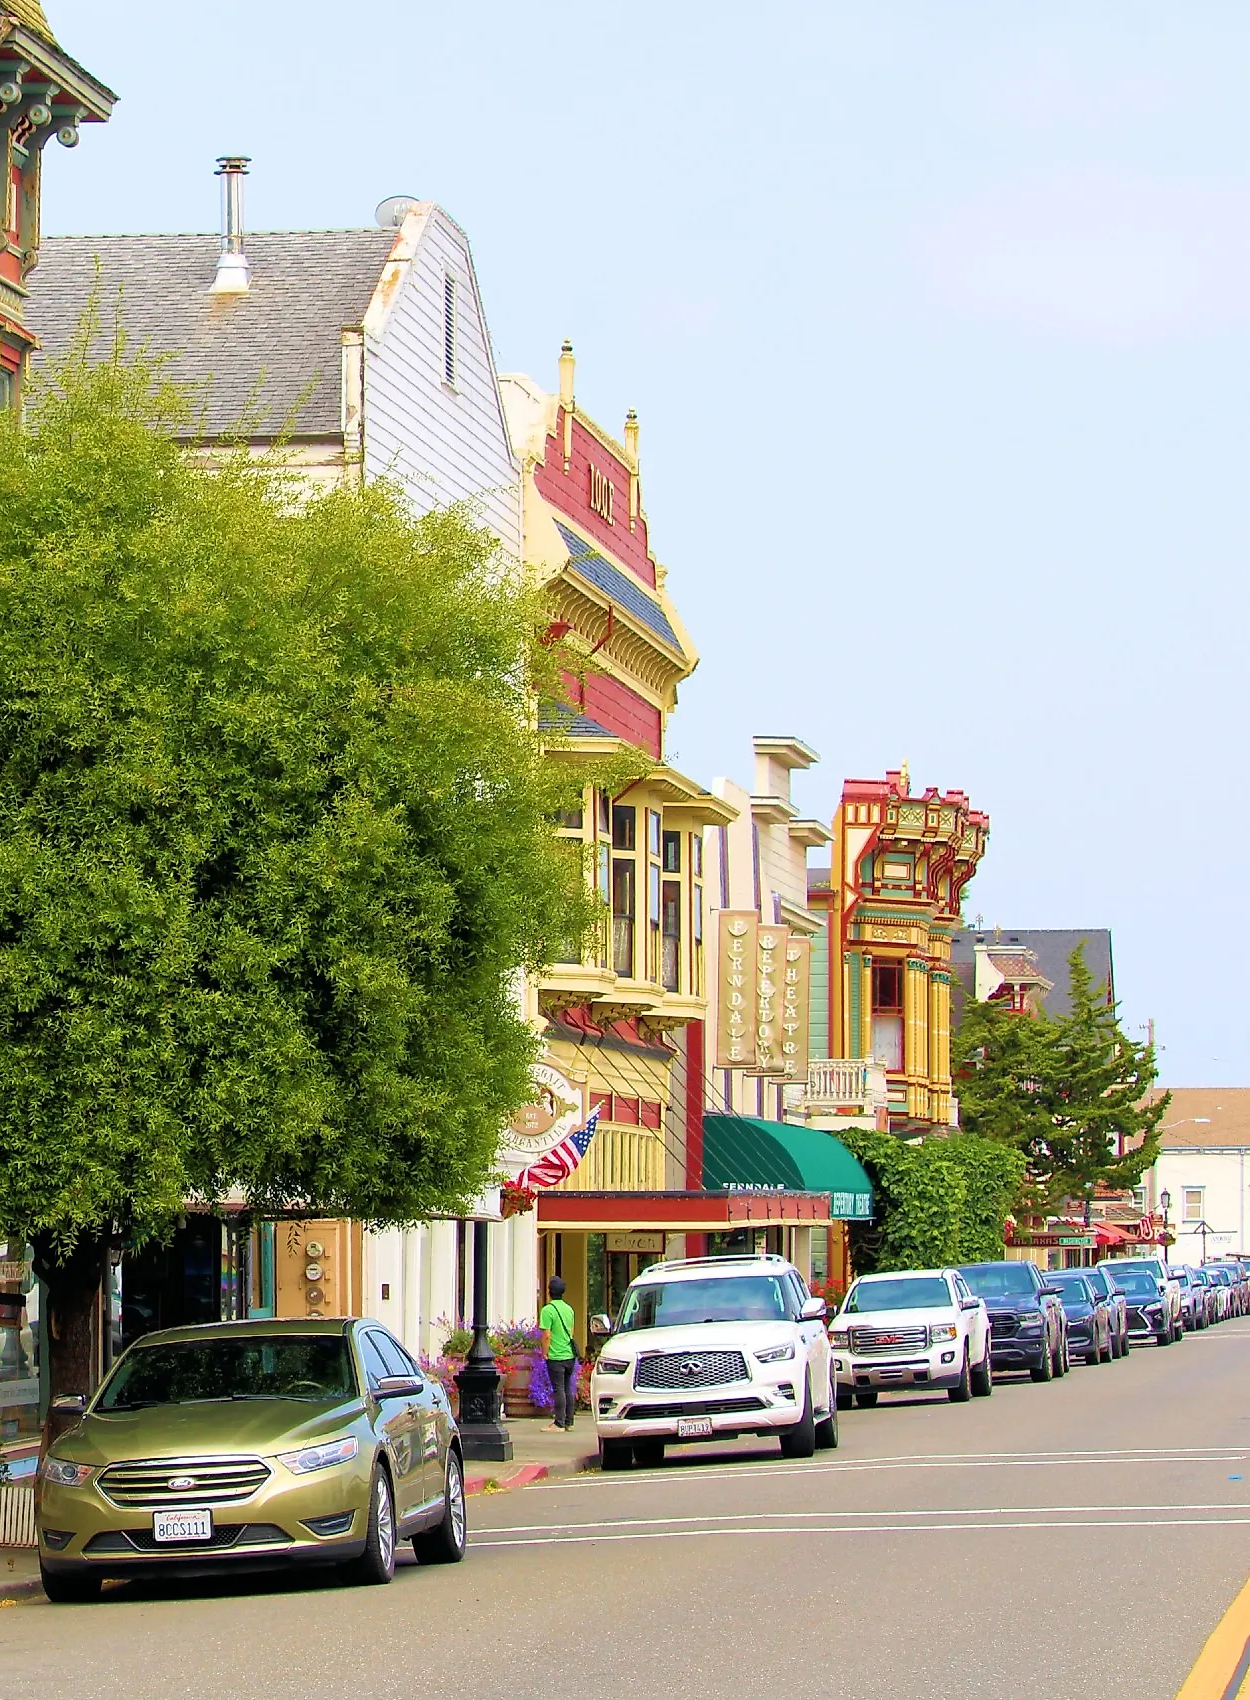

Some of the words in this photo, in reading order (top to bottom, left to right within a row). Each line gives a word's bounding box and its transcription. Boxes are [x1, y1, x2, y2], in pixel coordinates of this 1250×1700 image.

[731, 920, 744, 1060] FERNDALE
[759, 935, 775, 1068] REPERTORY
[783, 949, 798, 1073] THEATRE
[722, 1183, 784, 1191] FERNDALE
[158, 1521, 207, 1537] 8CCS111
